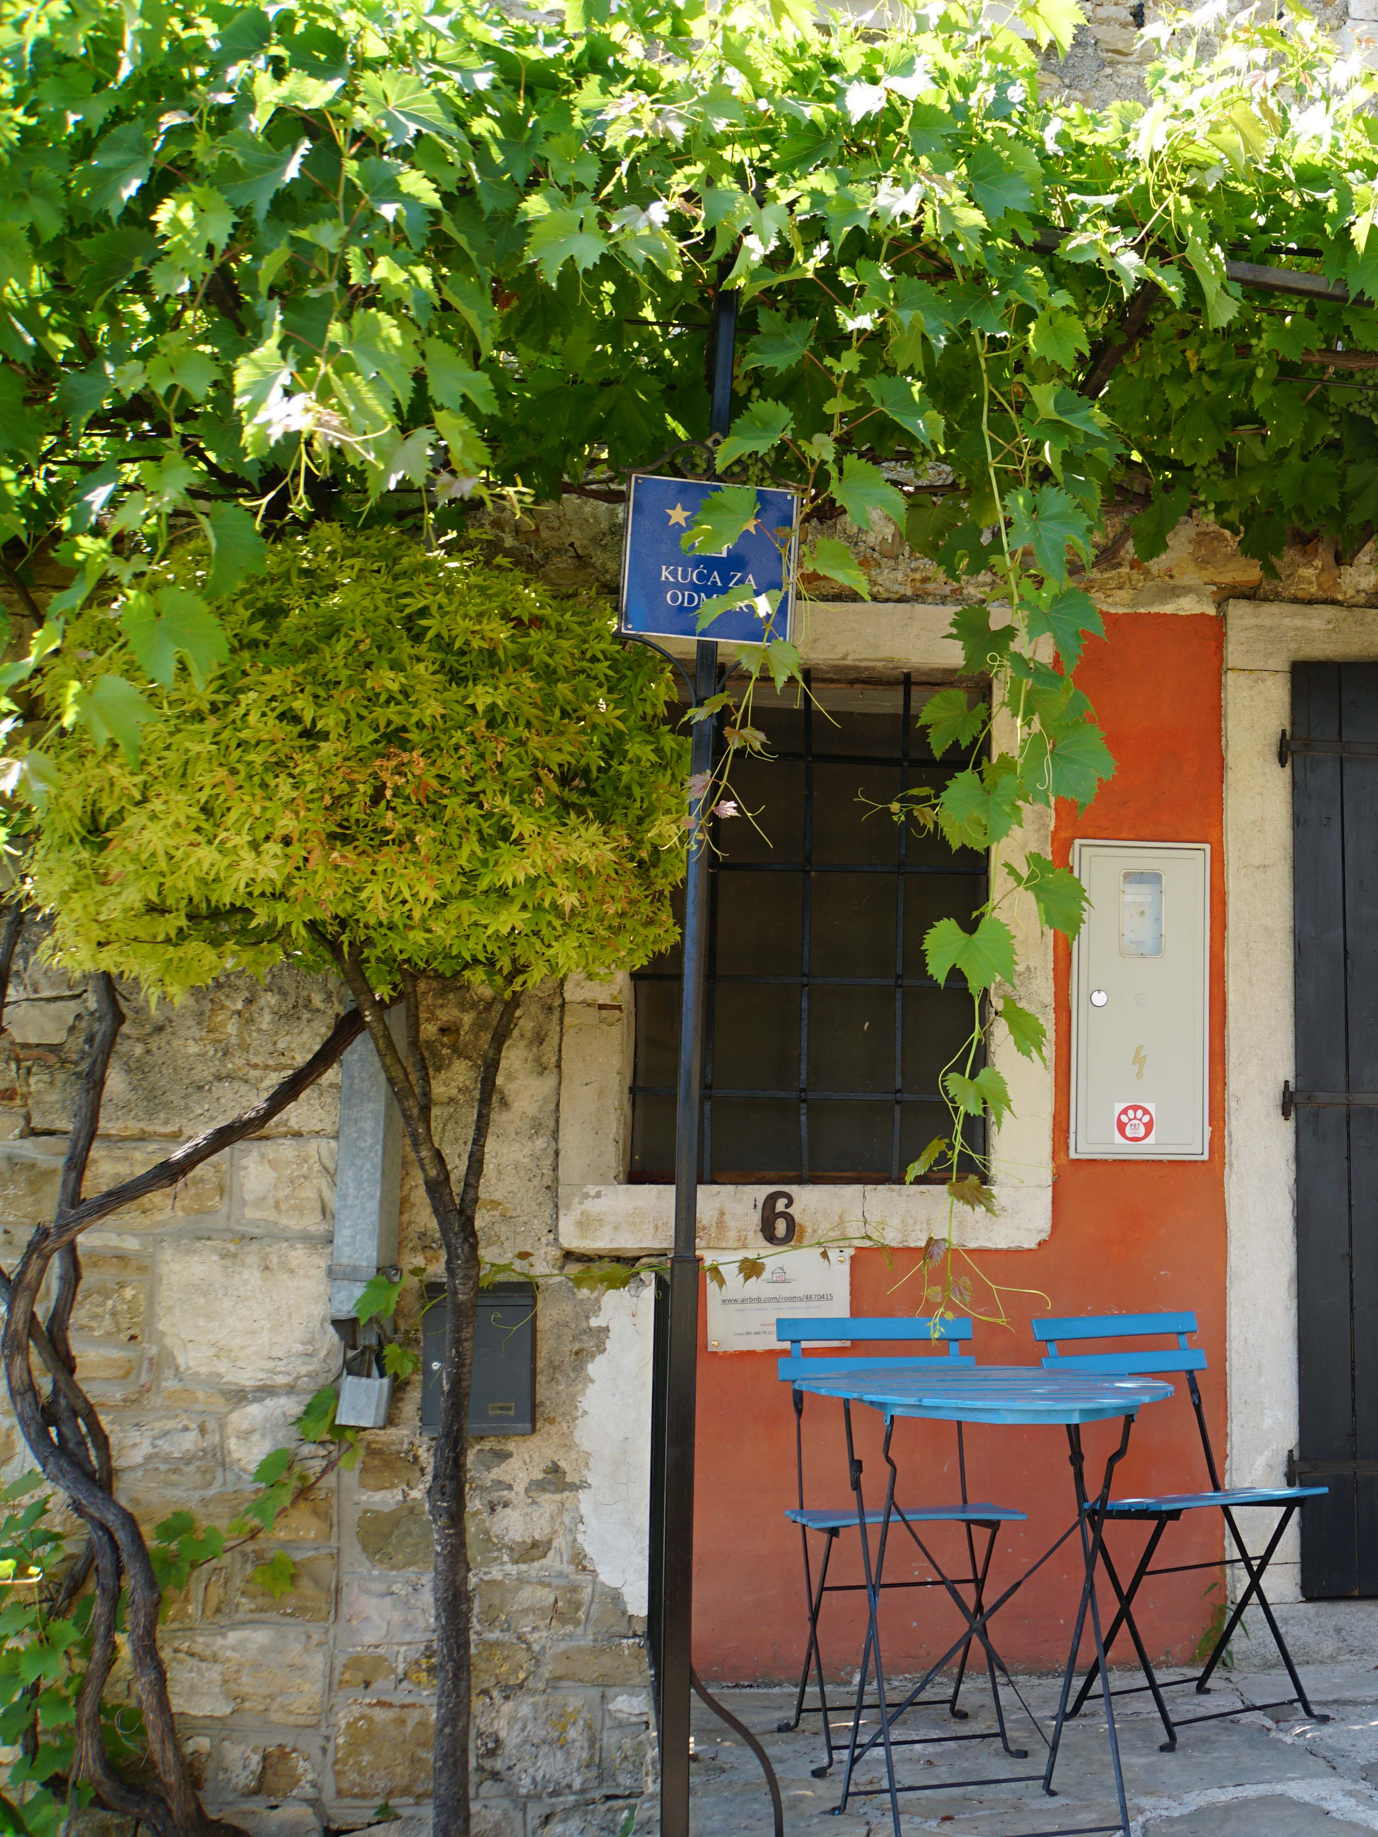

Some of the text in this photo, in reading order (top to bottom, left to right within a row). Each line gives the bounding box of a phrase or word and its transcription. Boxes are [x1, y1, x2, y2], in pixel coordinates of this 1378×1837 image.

[660, 564, 757, 589] KUĆA ZA
[760, 1190, 796, 1246] 6
[721, 1293, 834, 1305] www.airbnb.com/rooms/4870415
